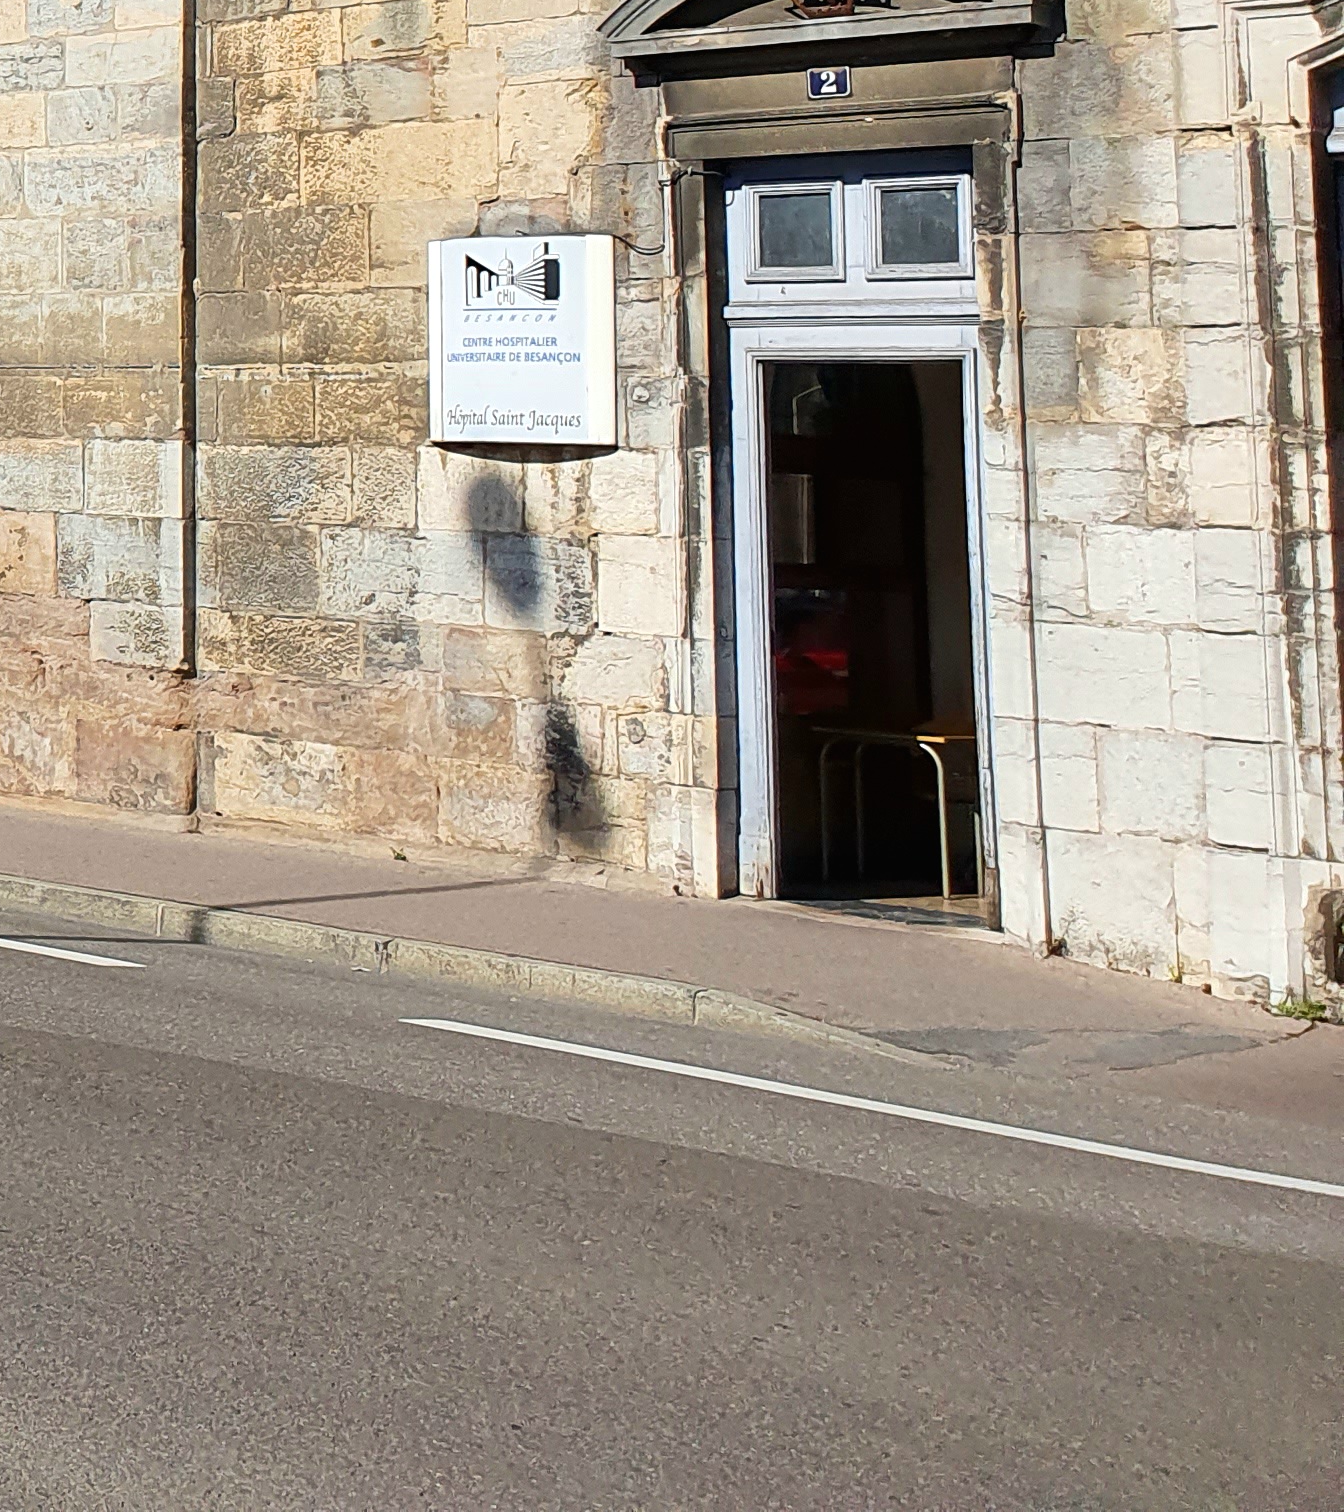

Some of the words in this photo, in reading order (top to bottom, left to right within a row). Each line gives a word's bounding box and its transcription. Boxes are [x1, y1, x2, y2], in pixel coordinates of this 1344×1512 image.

[820, 70, 837, 94] 2
[496, 288, 516, 306] CHU
[462, 337, 493, 348] CENTRE
[495, 336, 558, 347] HOSPITALIER
[446, 352, 506, 363] UNIVERSITAIRE
[508, 352, 522, 362] DE
[524, 351, 581, 365] BESANÇON
[446, 403, 490, 434] Hôpital
[490, 408, 526, 426] Saint
[526, 409, 582, 435] Jacques
